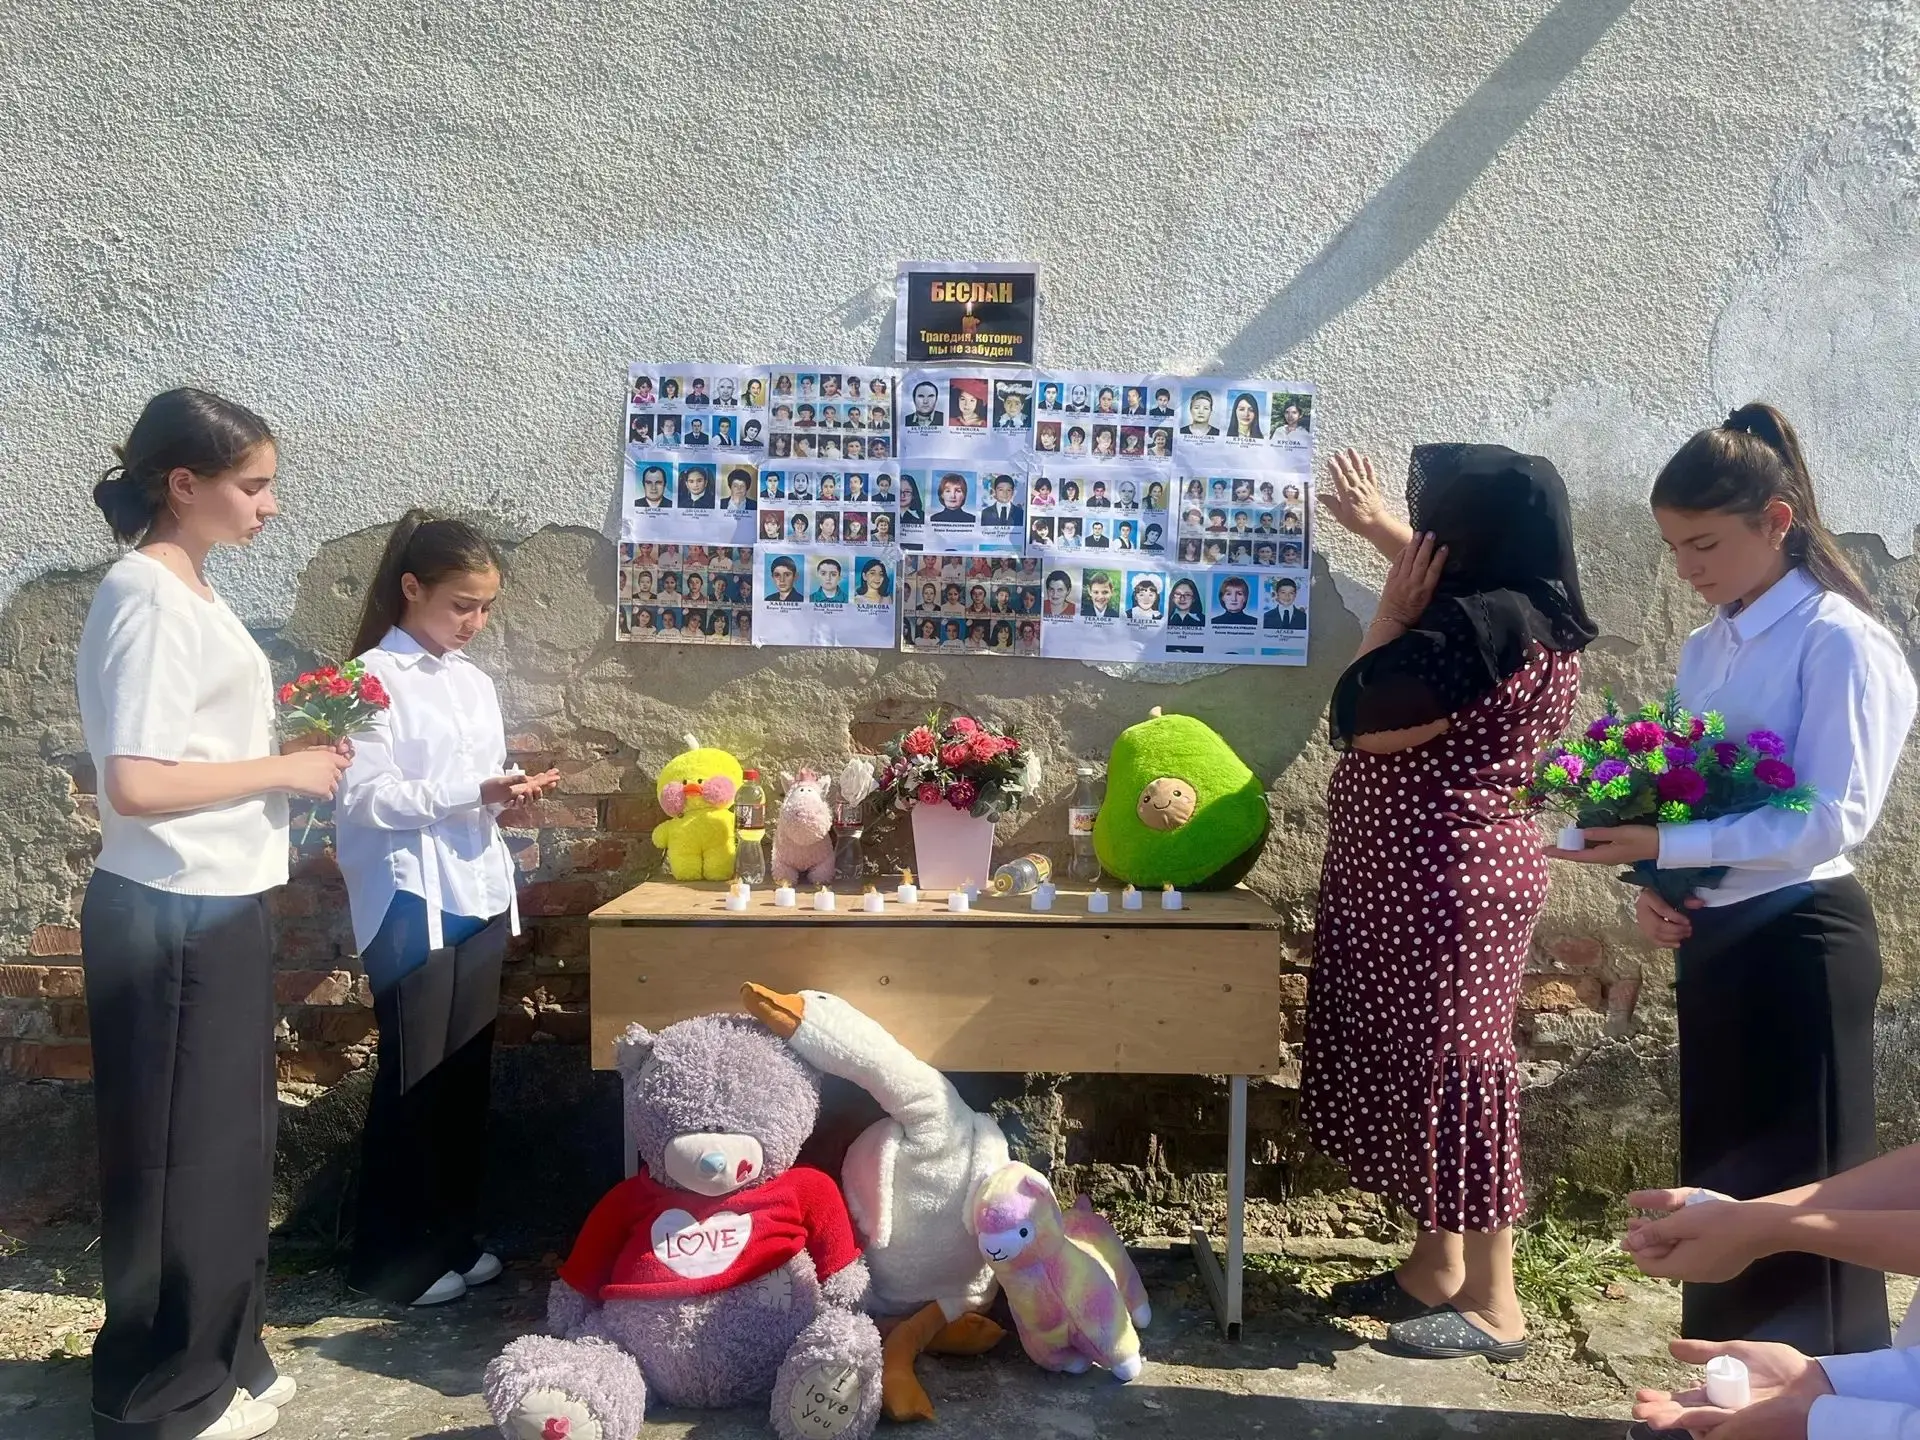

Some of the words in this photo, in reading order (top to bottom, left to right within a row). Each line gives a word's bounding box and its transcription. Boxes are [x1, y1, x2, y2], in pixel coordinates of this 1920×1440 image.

[930, 281, 1013, 303] БЕСЛАН
[920, 330, 973, 343] Трагедия,
[975, 333, 1023, 345] которую
[929, 346, 948, 355] мы
[950, 345, 963, 353] не
[965, 345, 1013, 357] забудем
[666, 1229, 739, 1258] LOVE
[806, 1384, 849, 1415] love
